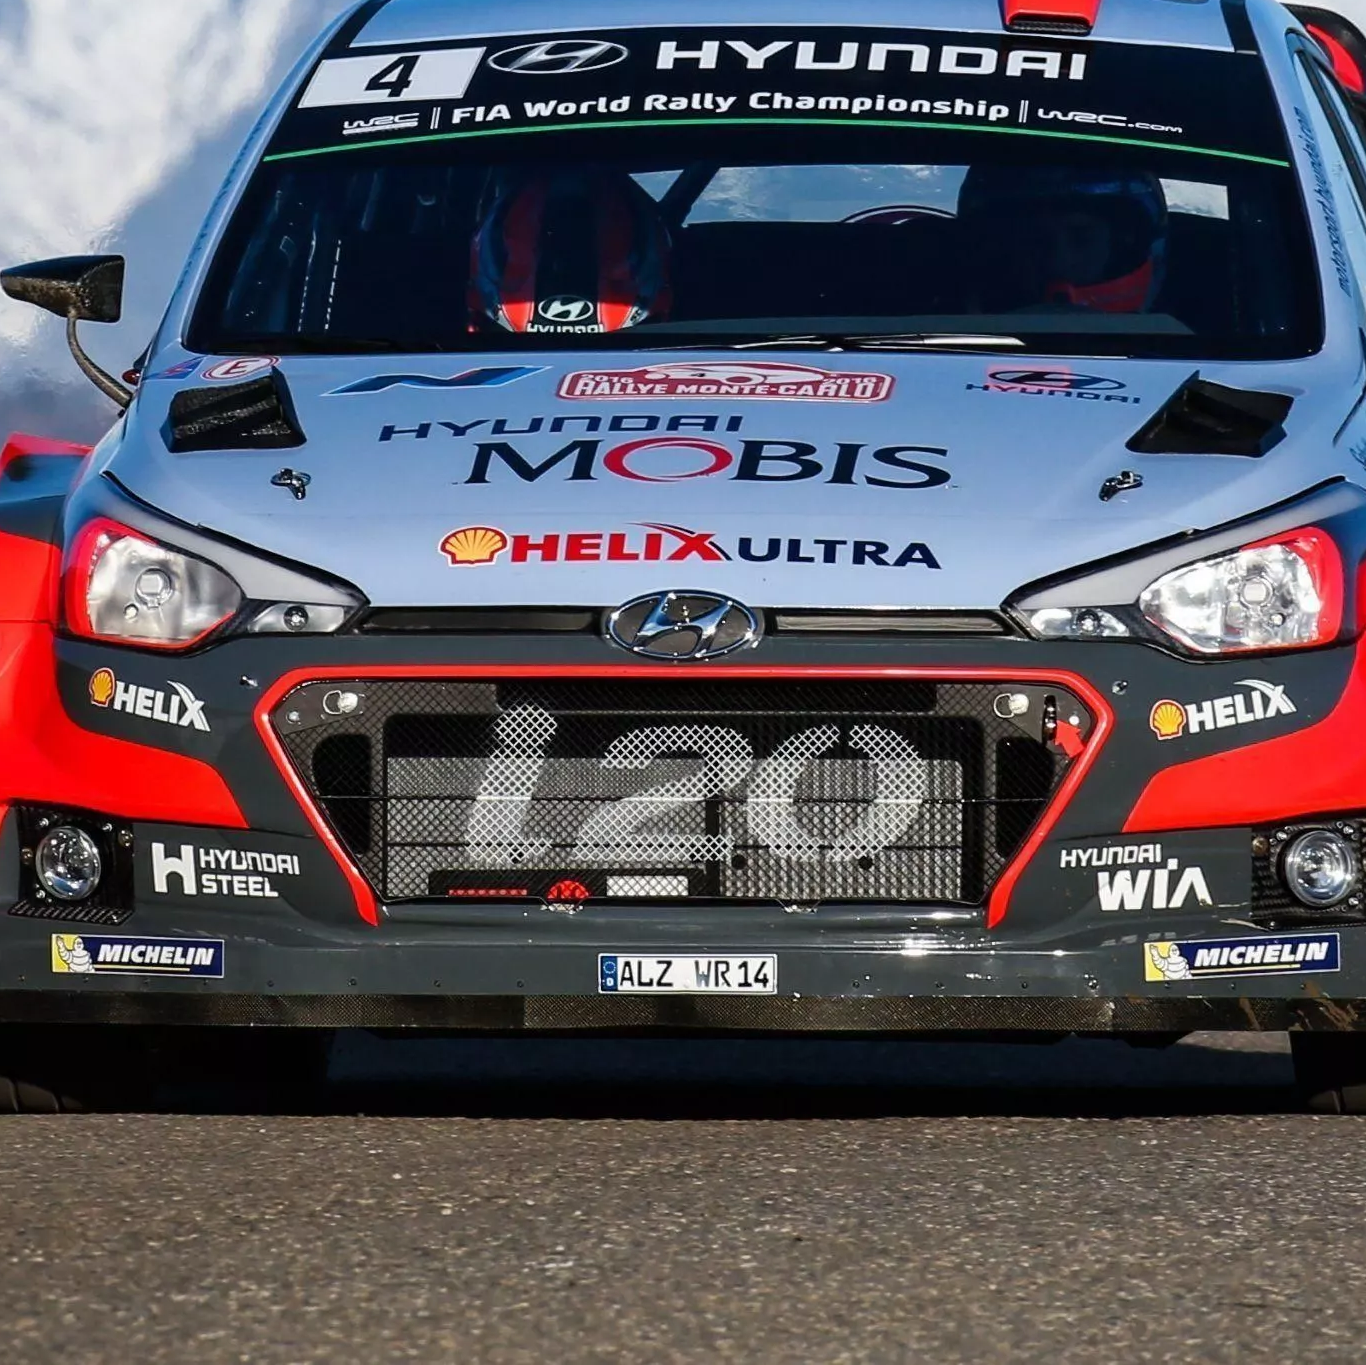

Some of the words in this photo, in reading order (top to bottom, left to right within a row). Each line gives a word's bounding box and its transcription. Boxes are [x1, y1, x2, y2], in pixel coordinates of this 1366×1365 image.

[656, 40, 1087, 80] HYUNDAI
[364, 54, 421, 97] 4
[344, 112, 420, 130] WRC
[451, 106, 512, 125] FIA
[523, 95, 631, 118] World
[643, 92, 737, 113] Rally
[748, 91, 1010, 122] Championship
[222, 359, 260, 375] E
[574, 379, 669, 396] RALLYE
[675, 381, 875, 398] MONTE-CARLO
[965, 383, 1141, 404] HYUNDAI
[378, 415, 744, 442] HYUNDAI
[463, 436, 952, 490] MOBIS
[511, 522, 733, 562] HELIX
[737, 537, 943, 570] ULTRA
[113, 680, 211, 732] HELIX
[1184, 679, 1297, 734] HELIX
[199, 848, 301, 876] HYUNDAI
[1060, 843, 1162, 869] HYUNDAI
[201, 873, 280, 898] STEEL
[97, 943, 215, 966] MICHELIN
[1193, 941, 1329, 968] MICHELIN
[619, 959, 674, 988] ALZ
